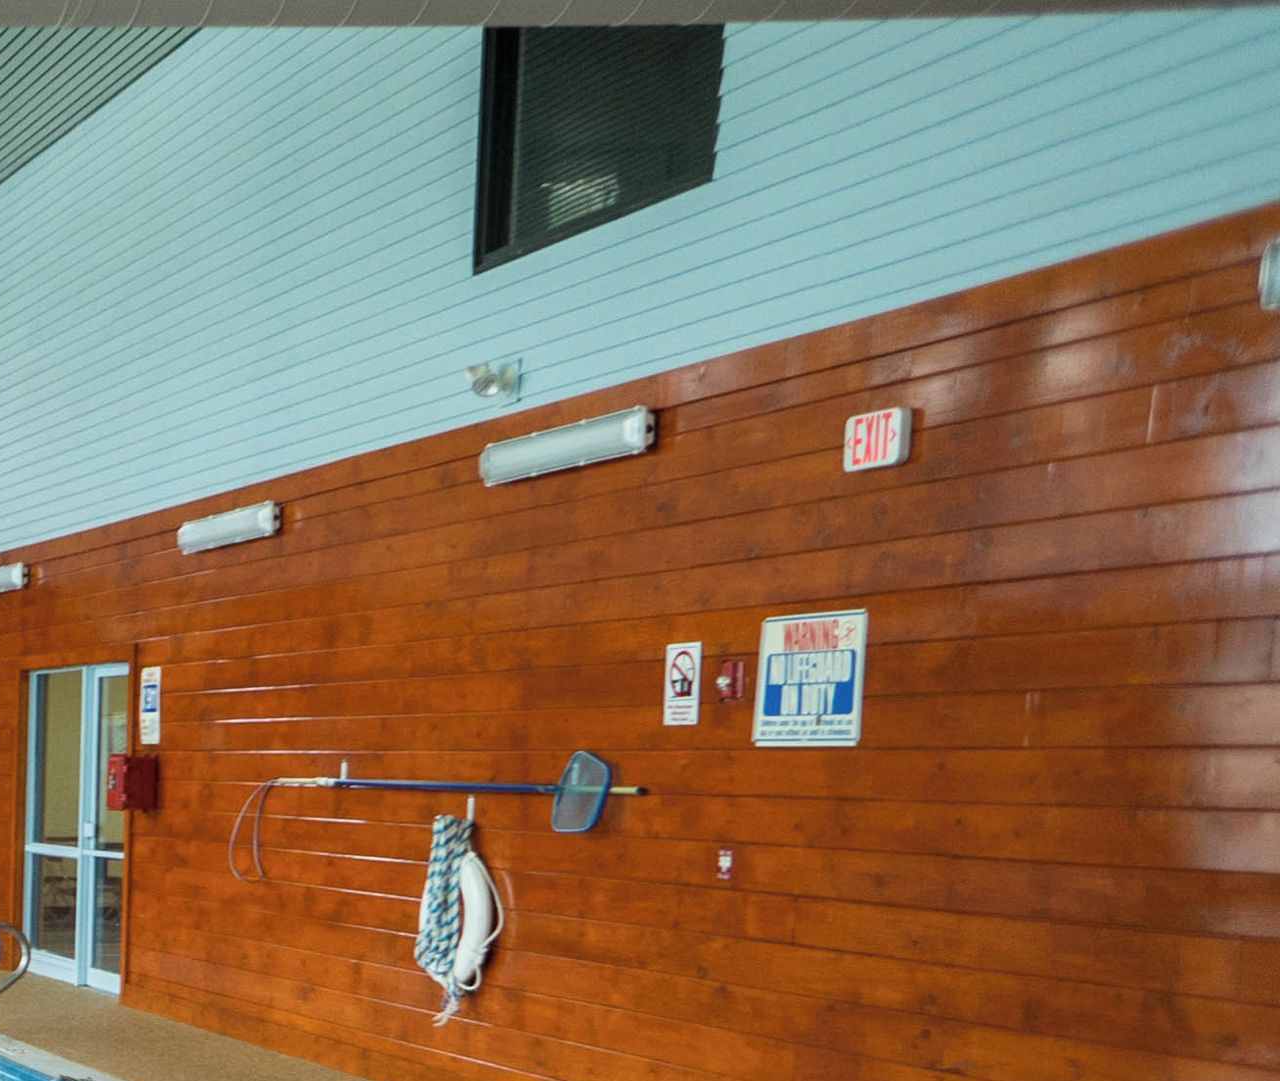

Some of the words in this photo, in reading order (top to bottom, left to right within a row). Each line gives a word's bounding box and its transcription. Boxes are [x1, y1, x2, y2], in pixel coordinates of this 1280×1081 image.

[852, 412, 892, 465] EXIT
[783, 619, 840, 651] WARNING
[801, 682, 836, 715] DUTY
